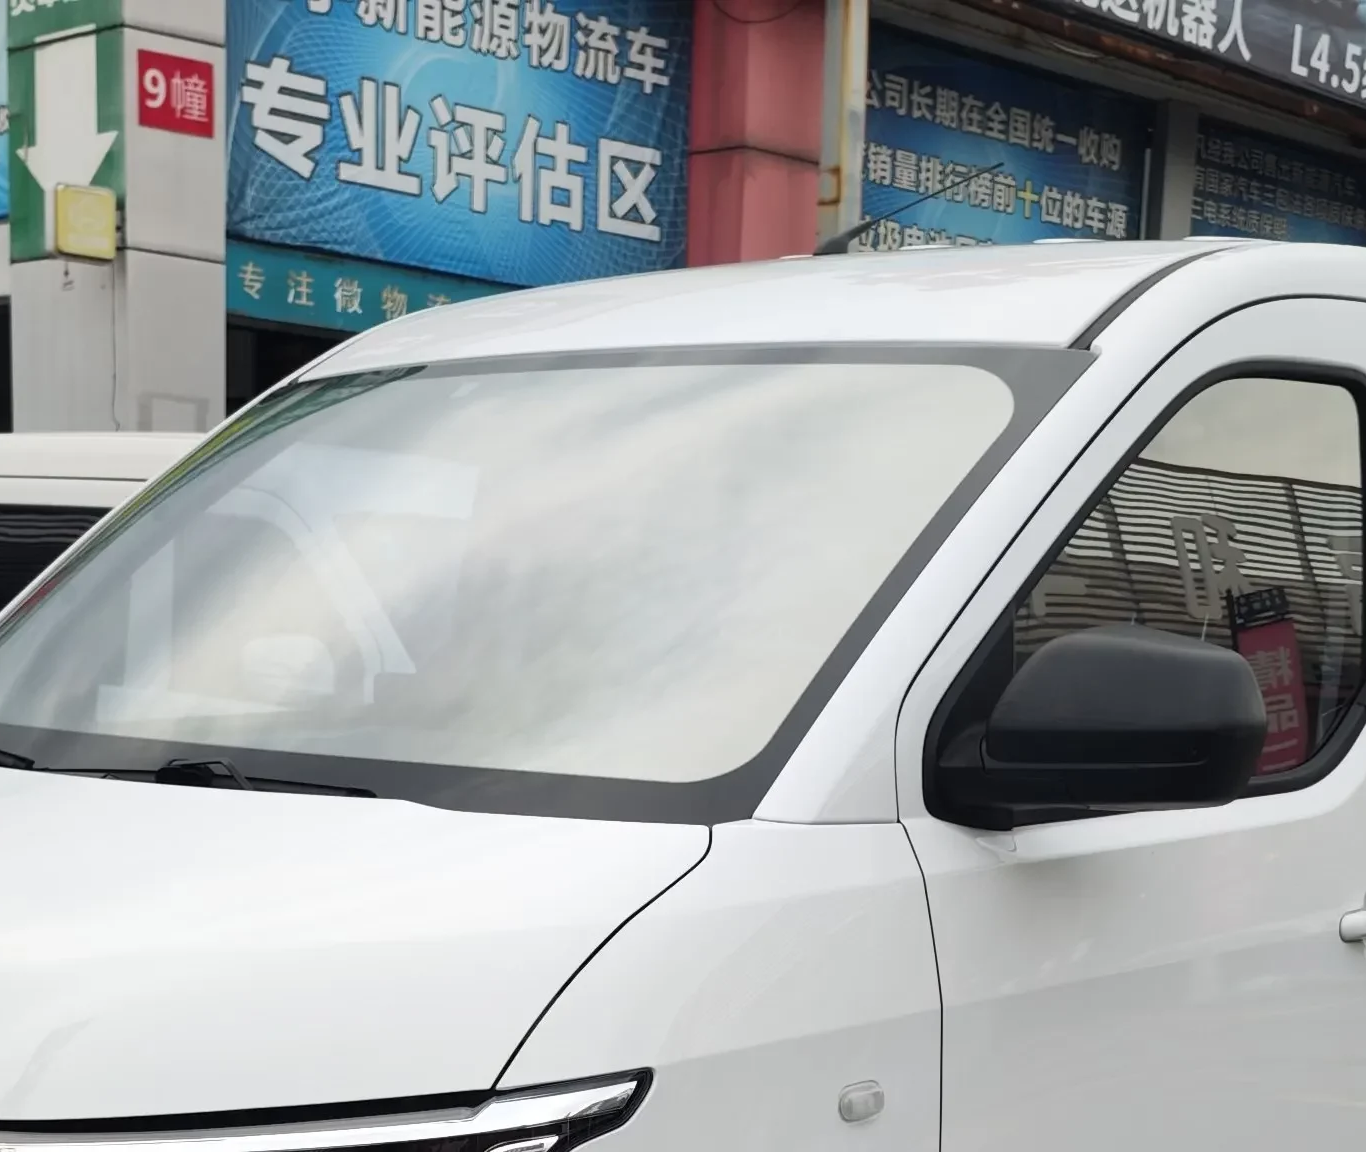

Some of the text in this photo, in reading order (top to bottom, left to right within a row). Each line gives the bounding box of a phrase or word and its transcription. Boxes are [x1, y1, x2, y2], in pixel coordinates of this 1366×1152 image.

[307, 0, 671, 94] 新能源物流车
[1076, 0, 1253, 62] 机器人
[142, 68, 210, 124] 9幢
[241, 56, 664, 243] 专业评估区
[862, 143, 1128, 239] 销量排行榜前十位的车源
